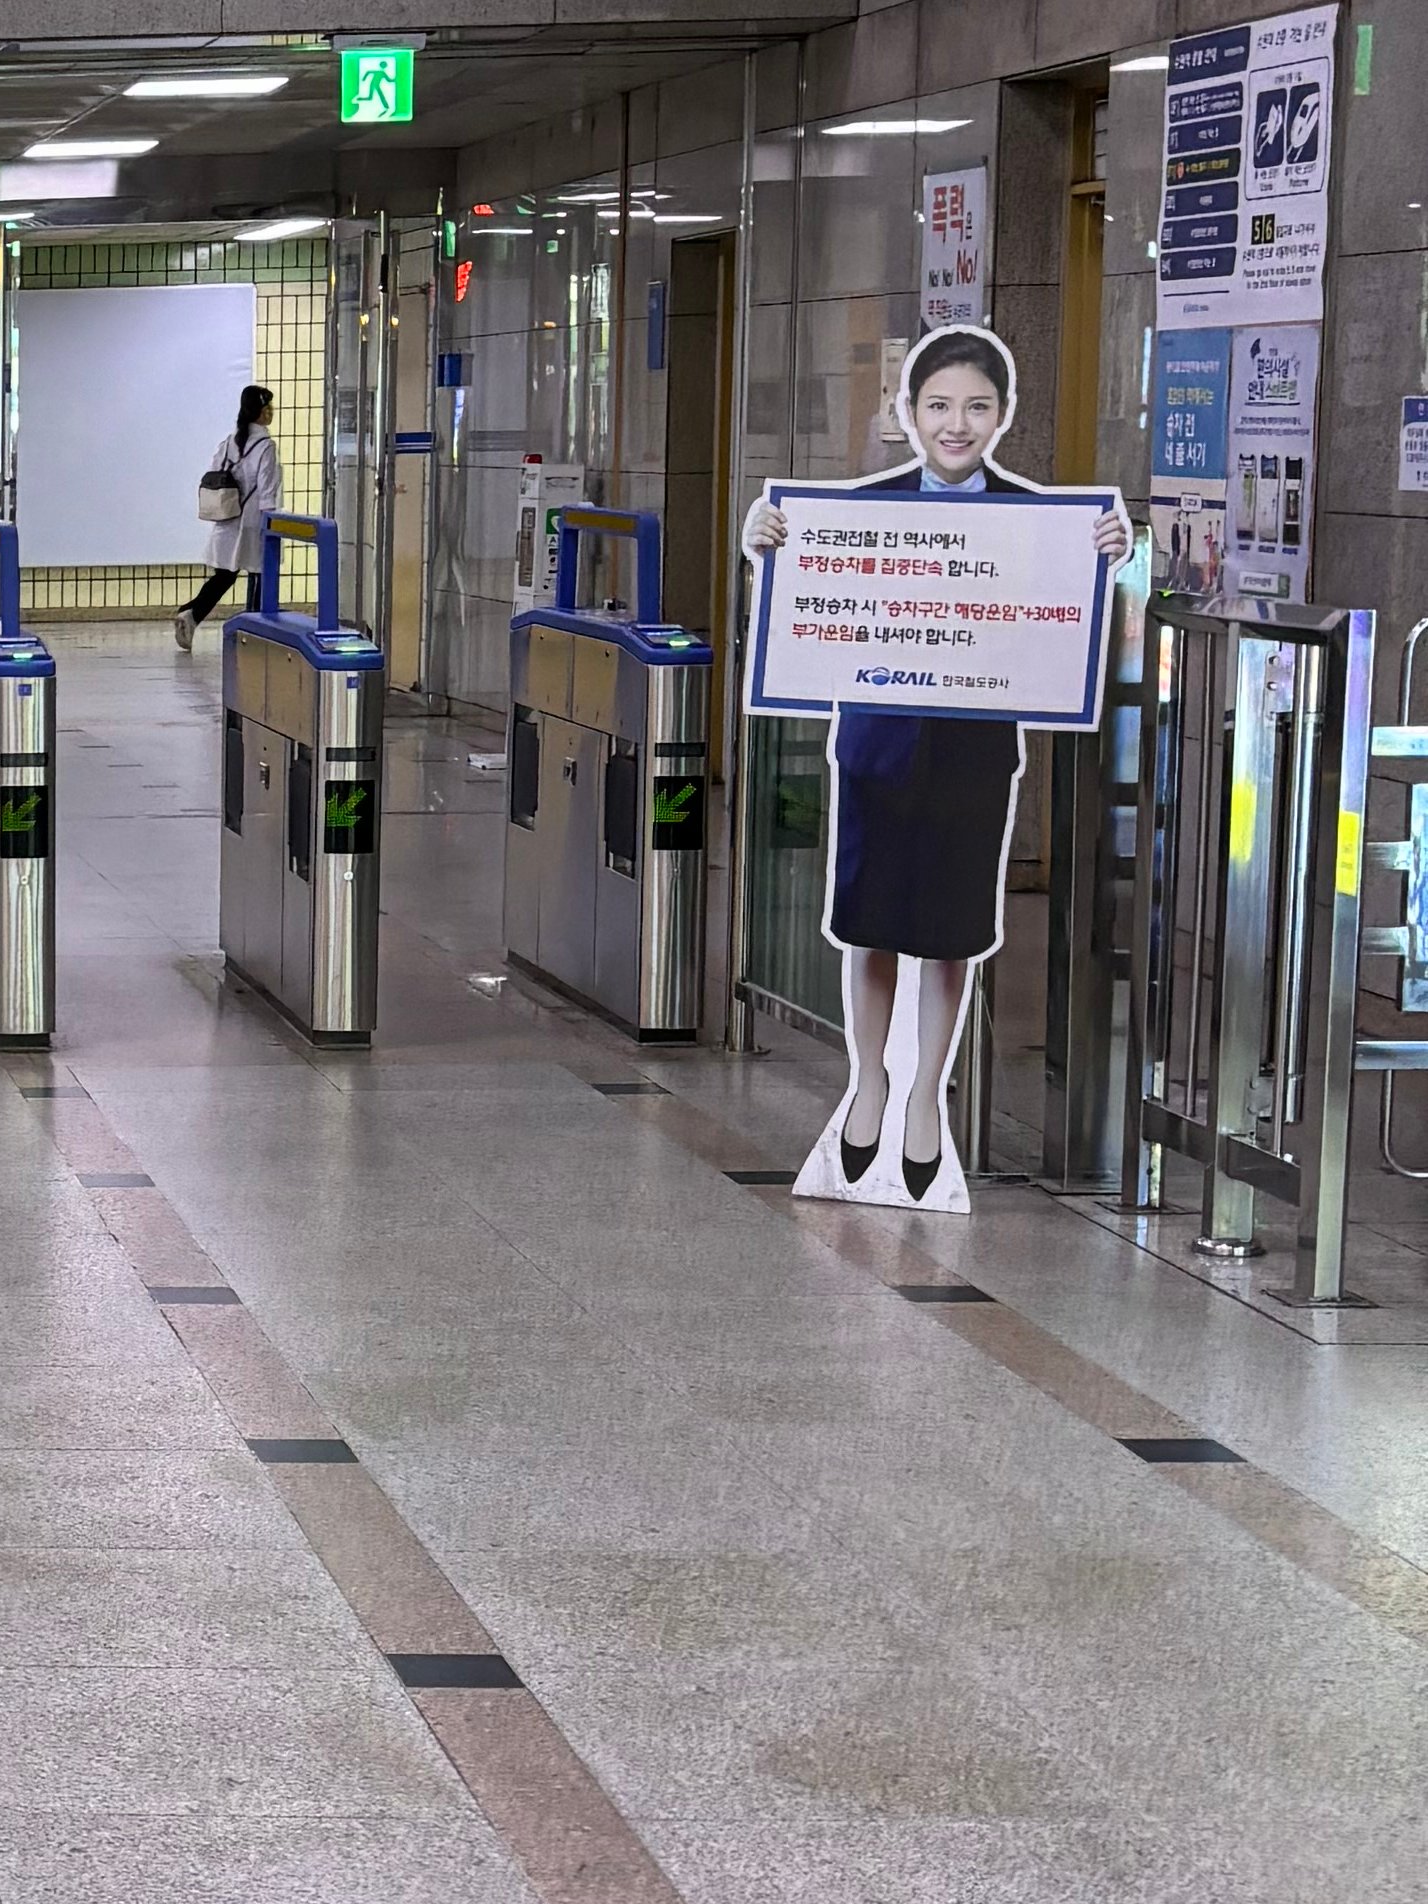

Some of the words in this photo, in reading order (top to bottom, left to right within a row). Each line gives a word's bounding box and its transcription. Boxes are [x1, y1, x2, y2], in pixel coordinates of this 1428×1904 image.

[956, 249, 978, 285] No!
[800, 529, 878, 548] 수도권전철
[883, 531, 898, 547] 전
[903, 531, 966, 550] 역사에서
[798, 554, 875, 575] 부정승차를
[881, 558, 943, 576] 집중단속
[947, 560, 1000, 578] 합니다.
[794, 596, 857, 616] 부정승차
[861, 599, 876, 616] 시
[792, 622, 870, 643] 부가운임을
[874, 625, 923, 645] 내셔야
[925, 628, 976, 648] 합니다.
[855, 666, 938, 688] KORAIL
[942, 674, 1010, 690] 한국철도공사
